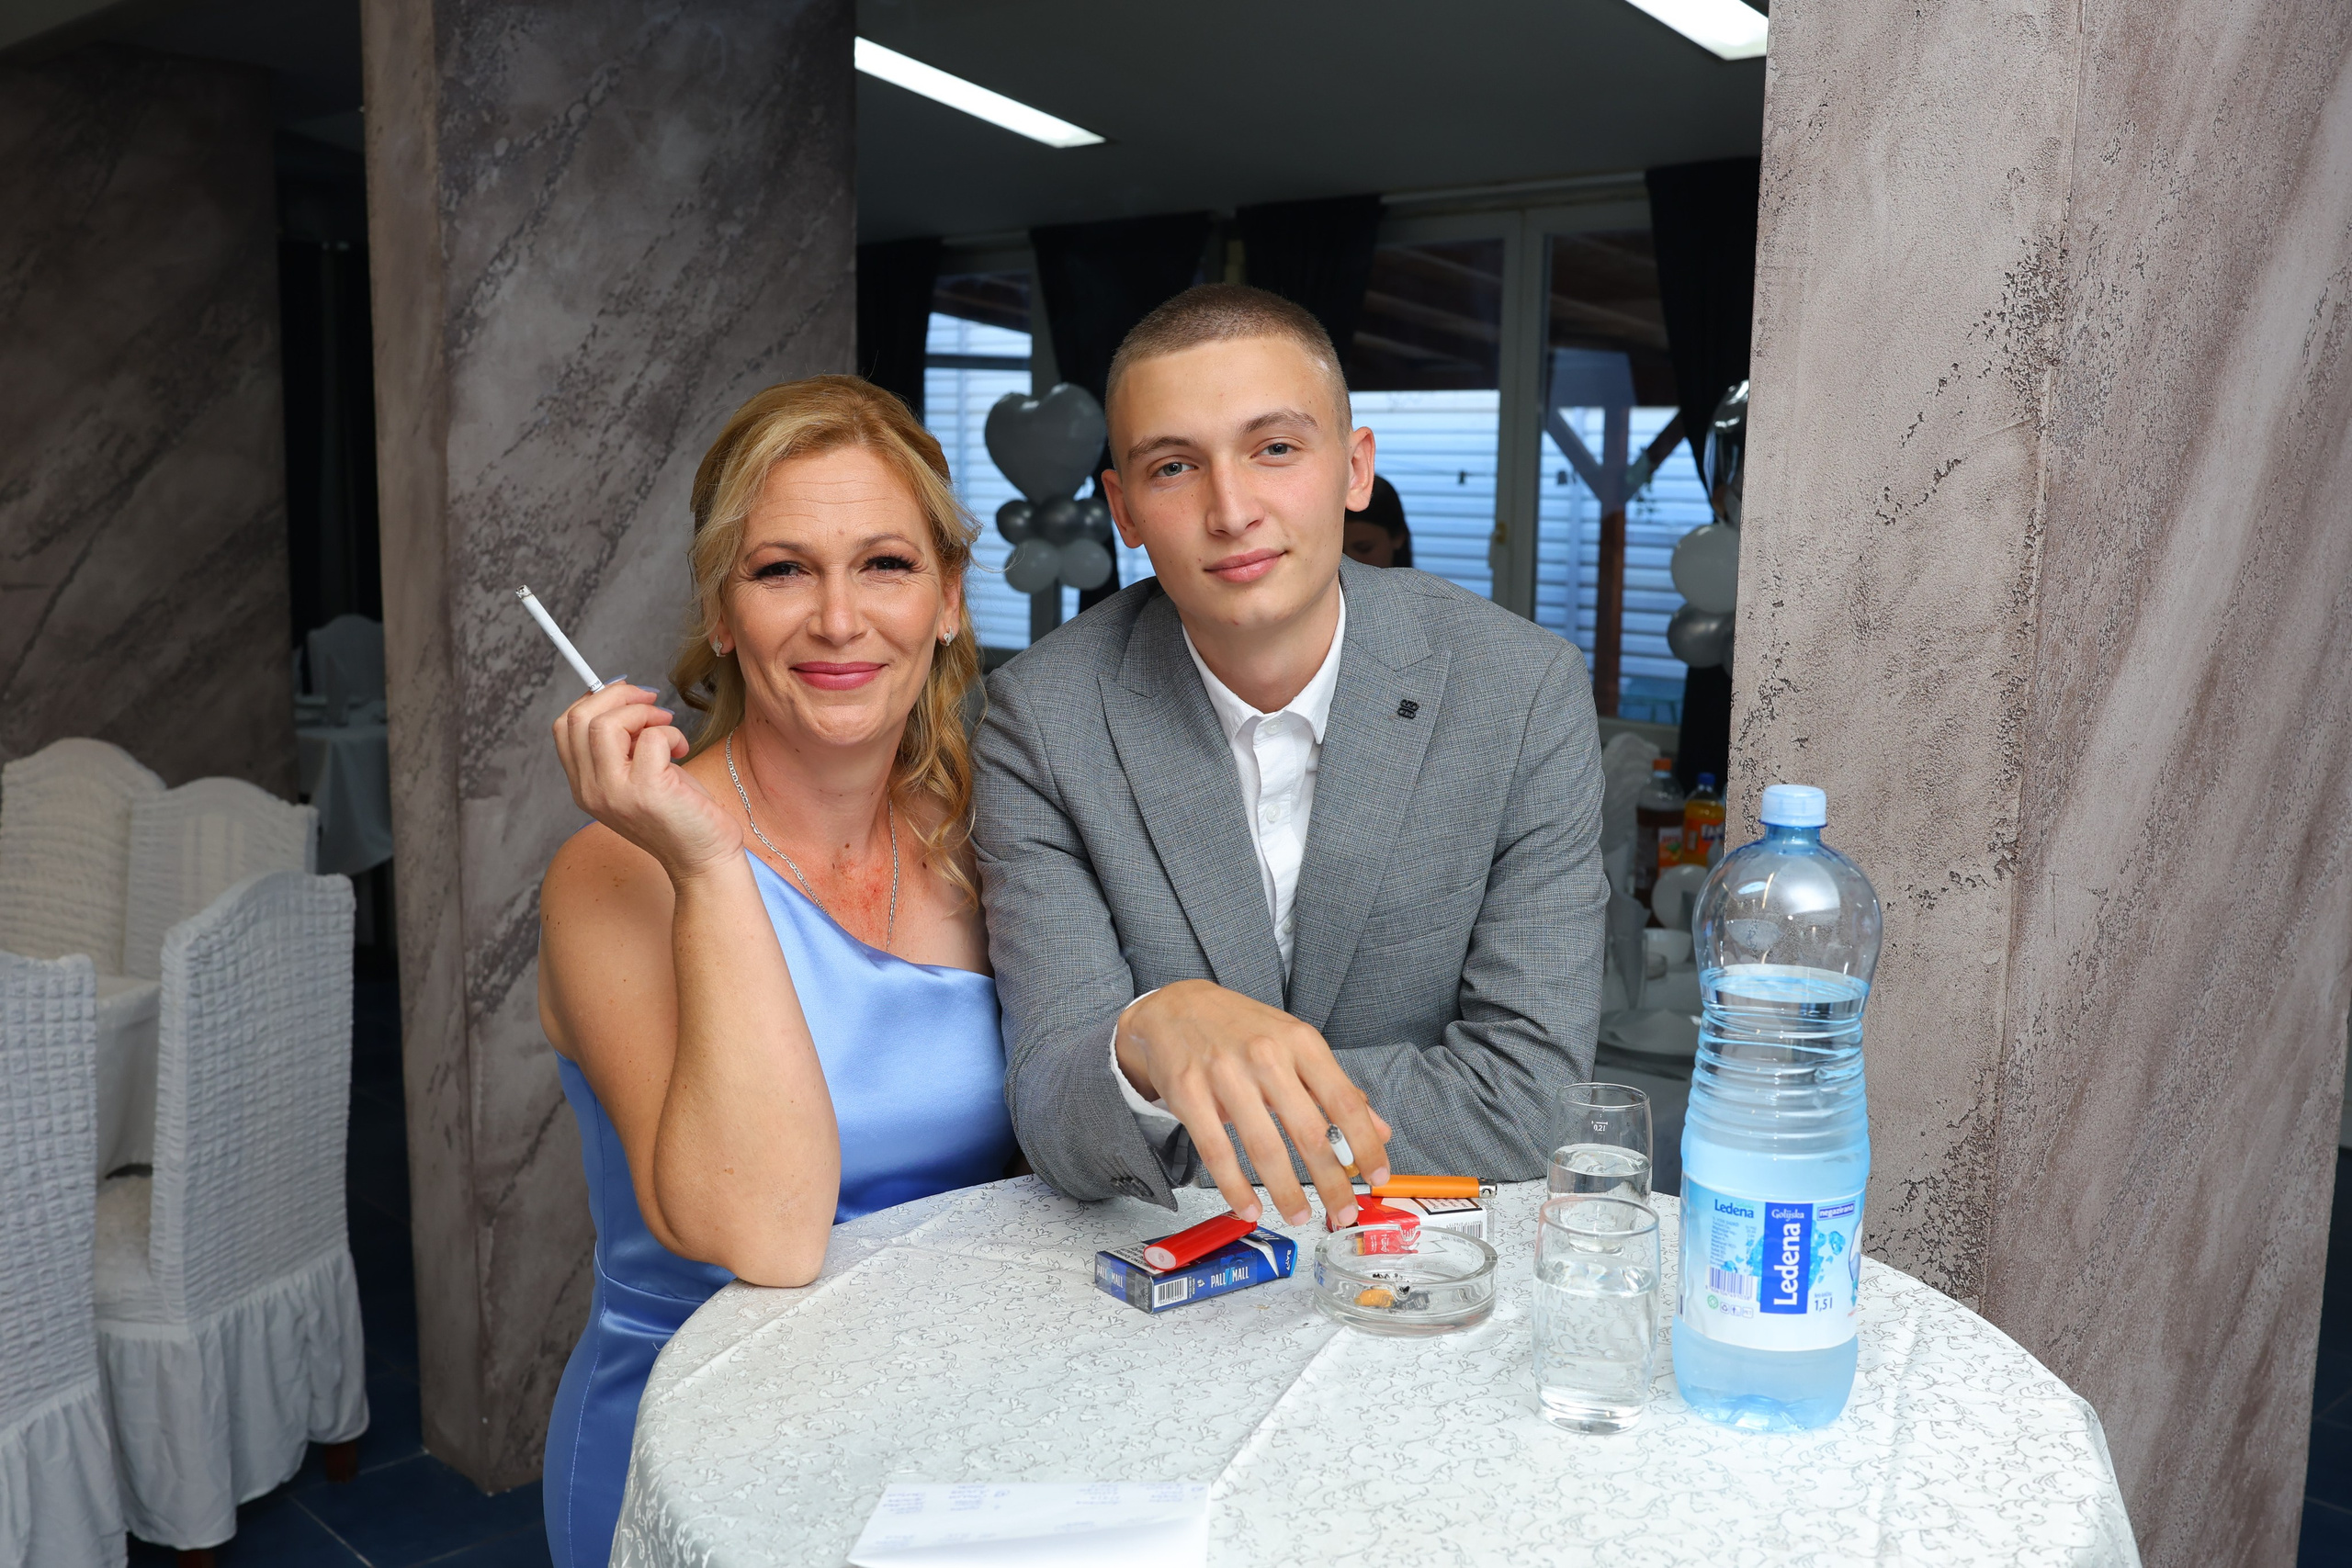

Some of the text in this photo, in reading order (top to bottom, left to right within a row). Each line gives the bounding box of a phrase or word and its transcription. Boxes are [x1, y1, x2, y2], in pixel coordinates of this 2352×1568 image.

[1714, 1199, 1754, 1219] Ledena
[1771, 1208, 1805, 1222] Golijska
[1773, 1223, 1801, 1305] Ledena
[1095, 1264, 1124, 1289] PALL MALL
[1210, 1272, 1227, 1289] PALL
[1232, 1266, 1250, 1282] MALL
